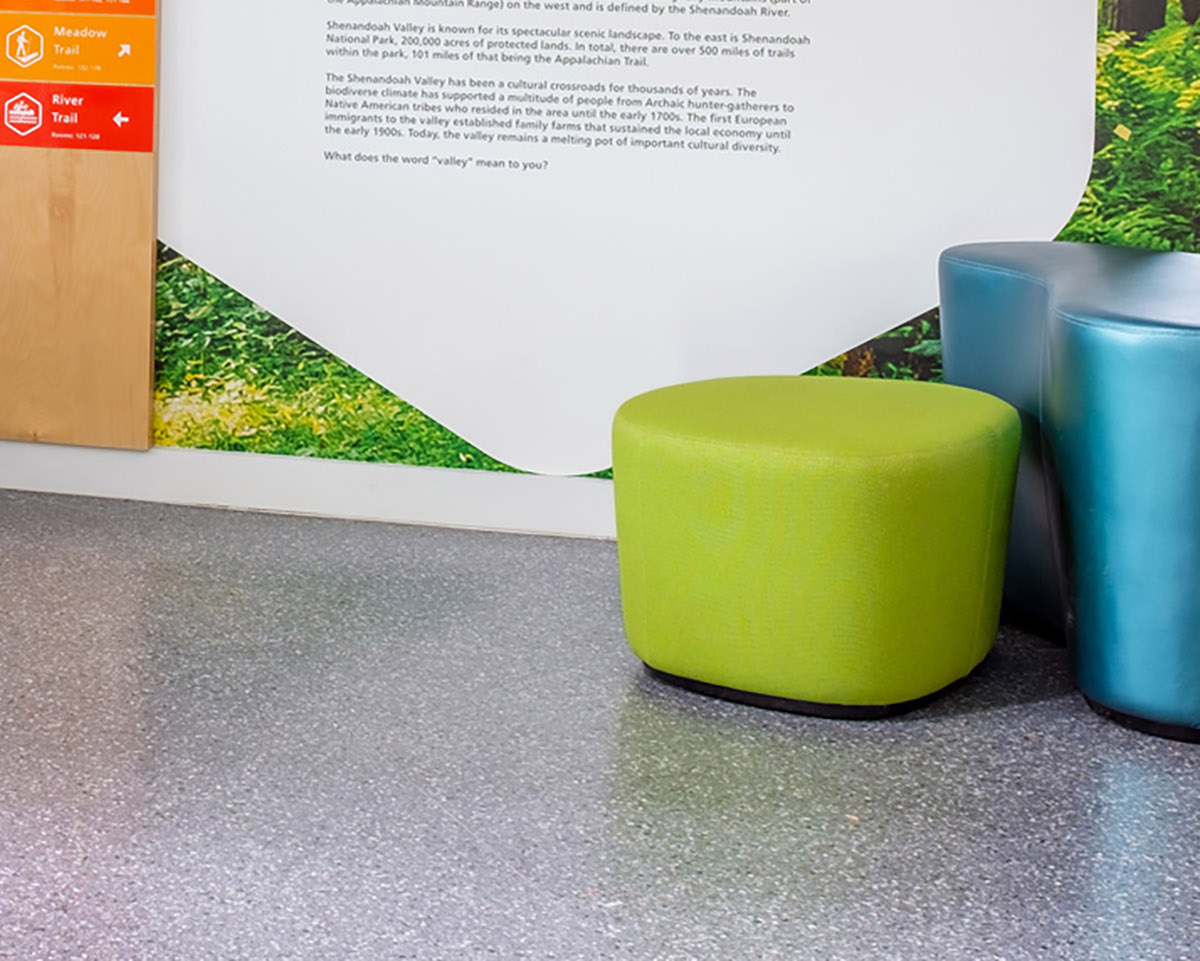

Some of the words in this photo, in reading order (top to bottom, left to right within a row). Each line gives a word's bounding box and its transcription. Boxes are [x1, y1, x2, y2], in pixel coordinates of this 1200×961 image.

[523, 0, 541, 9] the
[543, 1, 570, 10] west
[572, 1, 593, 11] and
[606, 1, 649, 12] defined
[667, 3, 686, 13] the
[688, 4, 757, 15] Shenandoah
[54, 26, 108, 38] Meadow
[326, 20, 391, 31] Shenandoah
[392, 22, 425, 35] Valley
[438, 23, 475, 34] known
[477, 24, 493, 35] for
[495, 25, 509, 35] its
[511, 27, 571, 38] spectacular
[573, 28, 606, 38] scenic
[682, 31, 701, 41] the
[703, 33, 727, 42] east
[741, 33, 810, 44] Shenandoah
[54, 44, 80, 55] Trail
[325, 33, 370, 44] National
[442, 39, 470, 47] acres
[486, 39, 538, 50] protected
[619, 42, 648, 53] there
[650, 45, 668, 53] are
[670, 46, 696, 54] over
[720, 45, 750, 56] miles
[767, 47, 795, 57] trails
[325, 46, 359, 57] within
[361, 47, 379, 58] the
[431, 49, 460, 60] miles
[476, 51, 499, 61] that
[500, 51, 531, 65] being
[533, 53, 552, 63] the
[553, 53, 621, 66] Appalachian
[325, 72, 344, 83] The
[346, 73, 412, 85] Shenandoah
[413, 75, 446, 89] Valley
[447, 77, 466, 87] has
[468, 77, 495, 88] been
[506, 79, 547, 90] cultural
[549, 82, 606, 92] crossroads
[608, 82, 625, 93] for
[627, 83, 684, 95] thousands
[736, 87, 757, 97] The
[52, 94, 83, 106] River
[324, 85, 378, 97] biodiverse
[380, 87, 419, 98] climate
[420, 89, 439, 99] has
[441, 91, 496, 103] supported
[506, 92, 560, 104] multitude
[575, 95, 614, 108] people
[615, 96, 642, 107] from
[644, 97, 685, 108] Archaic
[686, 99, 780, 112] hunter-gatherers
[52, 112, 78, 124] Trail
[324, 98, 358, 109] Native
[360, 100, 410, 111] American
[412, 102, 442, 112] tribes
[444, 103, 468, 113] who
[470, 104, 510, 115] resided
[524, 106, 543, 116] the
[545, 109, 569, 117] area
[571, 108, 597, 118] until
[598, 109, 617, 119] the
[619, 110, 647, 122] early
[686, 112, 707, 122] The
[734, 113, 787, 127] European
[324, 111, 383, 124] immigrants
[399, 114, 417, 124] the
[419, 115, 451, 128] valley
[452, 117, 513, 128] established
[514, 118, 548, 132] family
[550, 120, 582, 131] farms
[583, 121, 606, 132] that
[608, 123, 661, 134] sustained
[663, 125, 682, 135] the
[684, 125, 710, 136] local
[712, 128, 763, 140] economy
[765, 129, 791, 139] until
[324, 124, 341, 134] the
[343, 125, 370, 138] early
[442, 129, 461, 139] the
[462, 130, 495, 143] valley
[496, 132, 539, 142] remains
[550, 134, 592, 147] melting
[594, 136, 613, 147] pot
[630, 136, 685, 149] important
[687, 139, 729, 150] cultural
[323, 150, 352, 161] What
[353, 151, 379, 162] does
[381, 153, 399, 163] the
[400, 154, 429, 164] word
[475, 159, 505, 167] mean
[521, 159, 548, 171] you?
